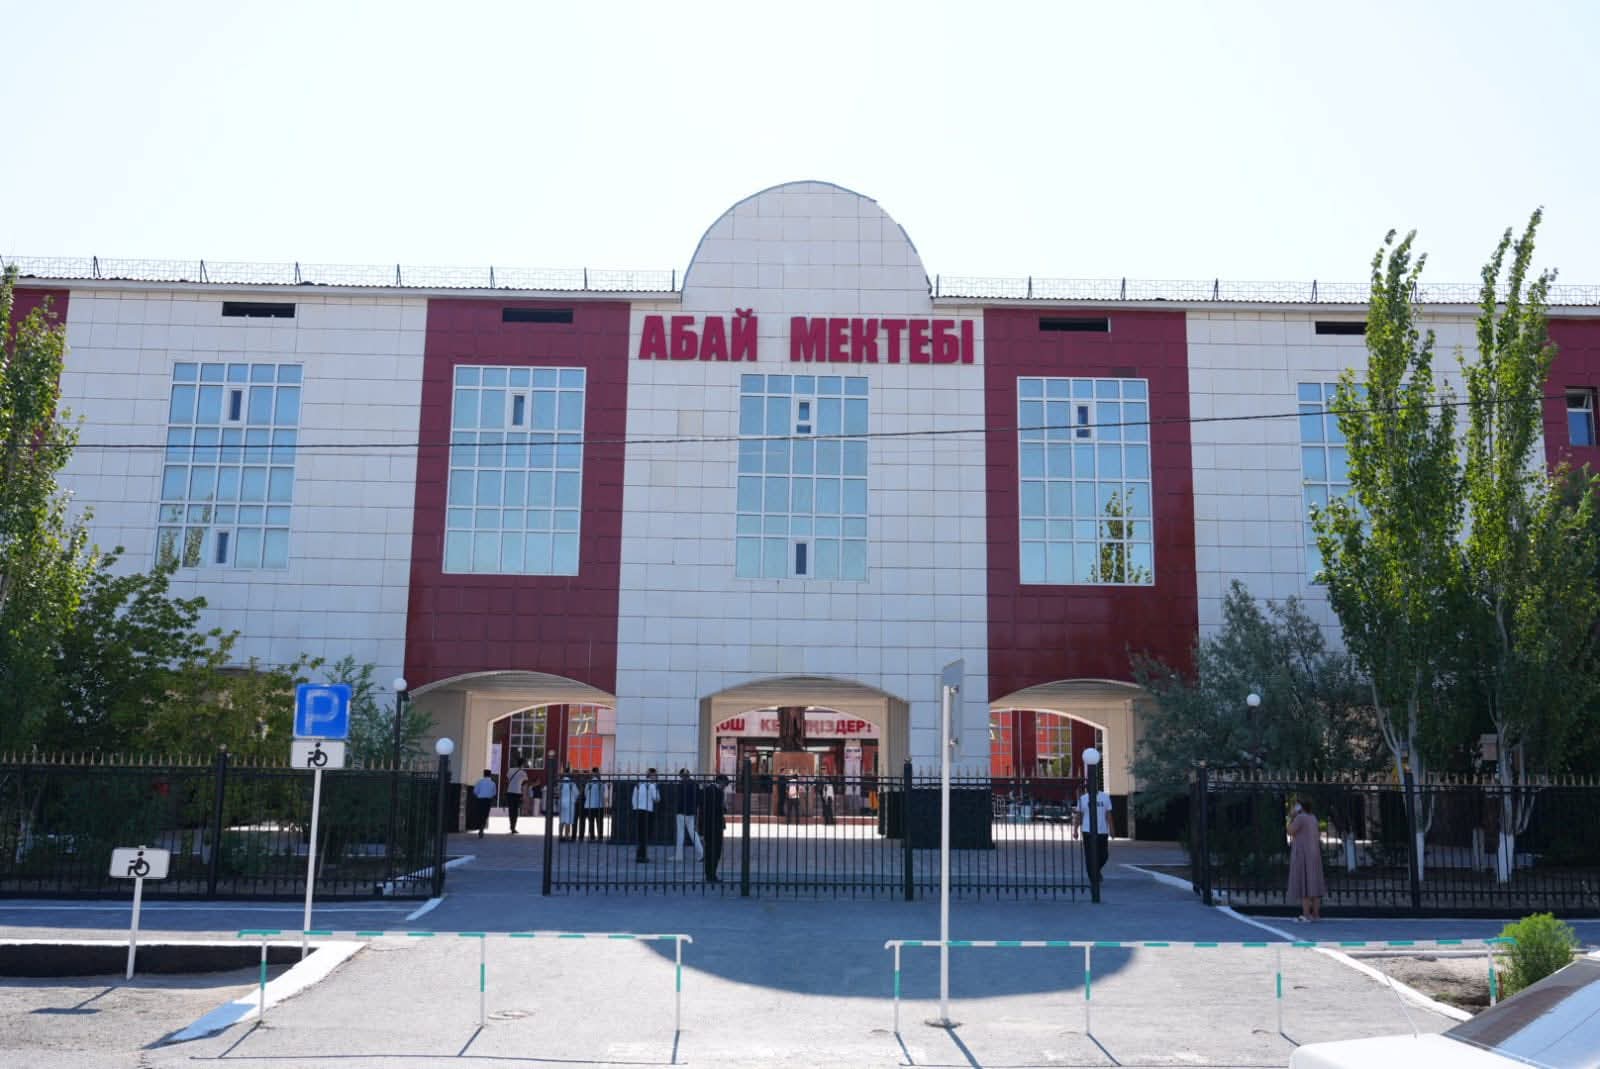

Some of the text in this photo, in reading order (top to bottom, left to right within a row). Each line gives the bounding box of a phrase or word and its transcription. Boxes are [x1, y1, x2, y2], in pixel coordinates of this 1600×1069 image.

[638, 308, 975, 364] АБАЙ МЕКТЕБІ
[304, 689, 339, 736] P
[716, 718, 745, 733] ОШ
